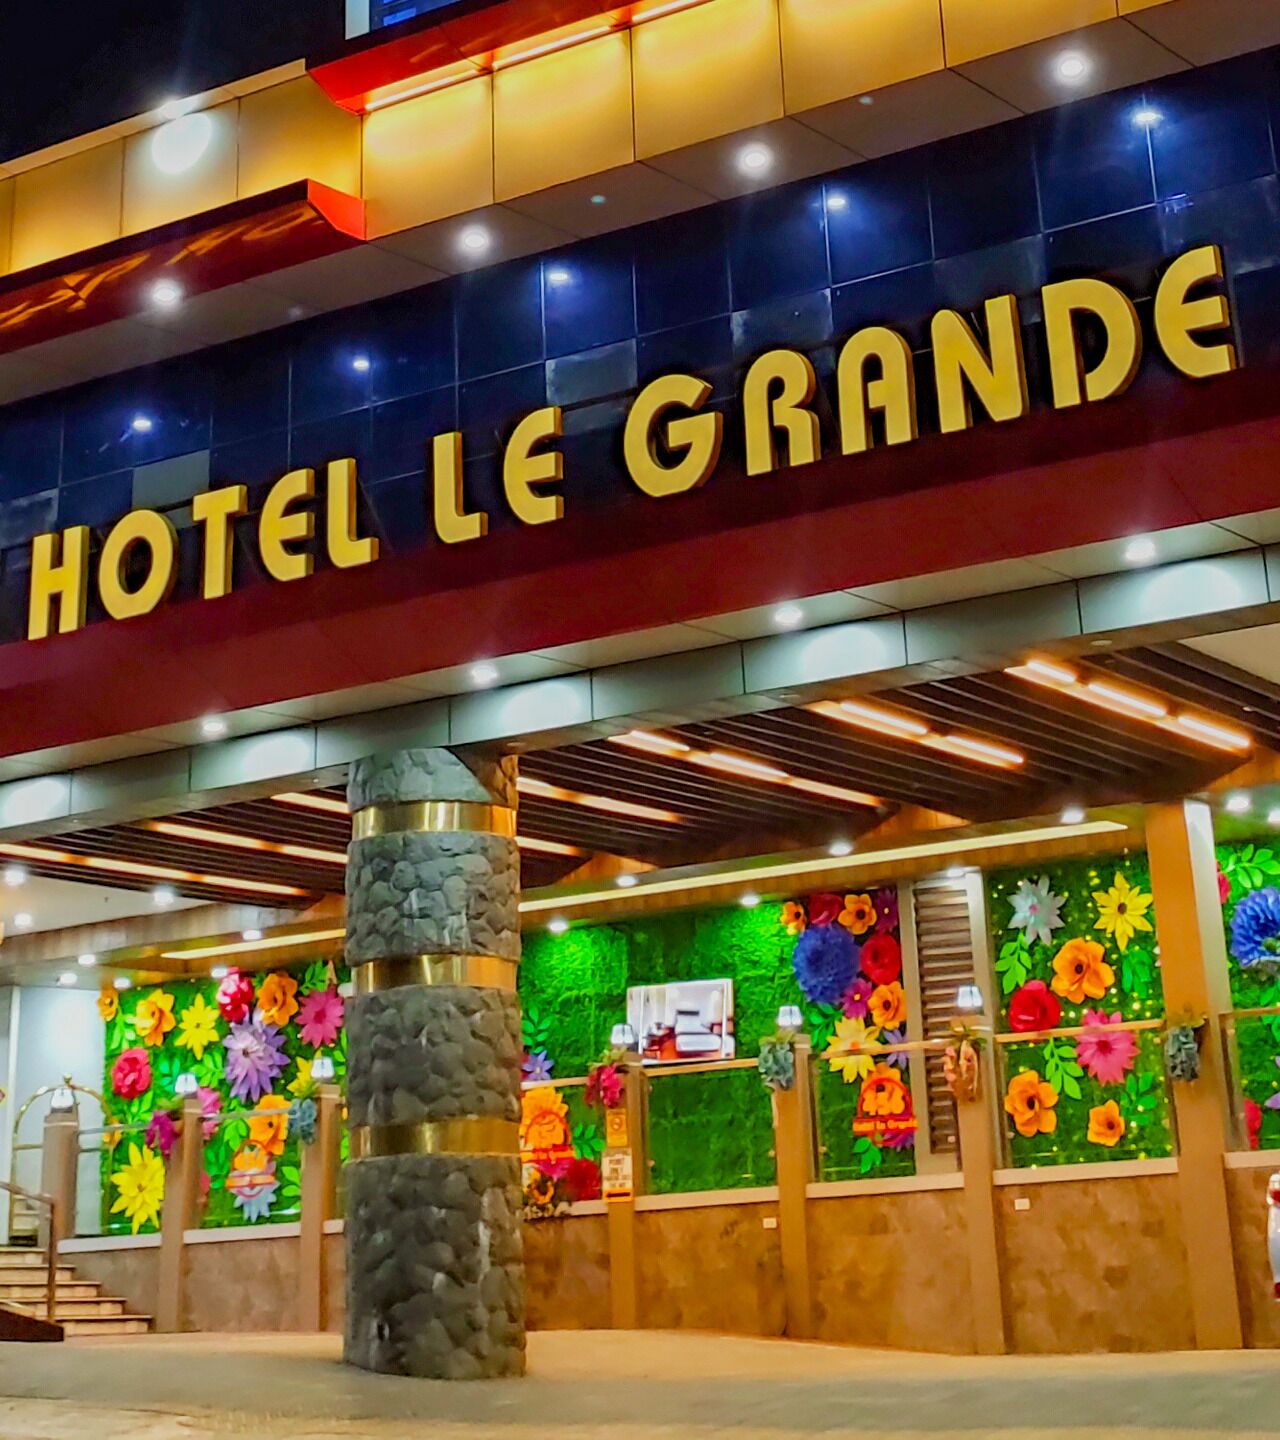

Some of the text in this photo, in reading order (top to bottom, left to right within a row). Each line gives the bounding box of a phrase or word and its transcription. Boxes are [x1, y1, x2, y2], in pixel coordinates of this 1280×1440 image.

[26, 458, 382, 642] HOTEL
[432, 406, 567, 546] LE
[622, 245, 1239, 500] GRANDE
